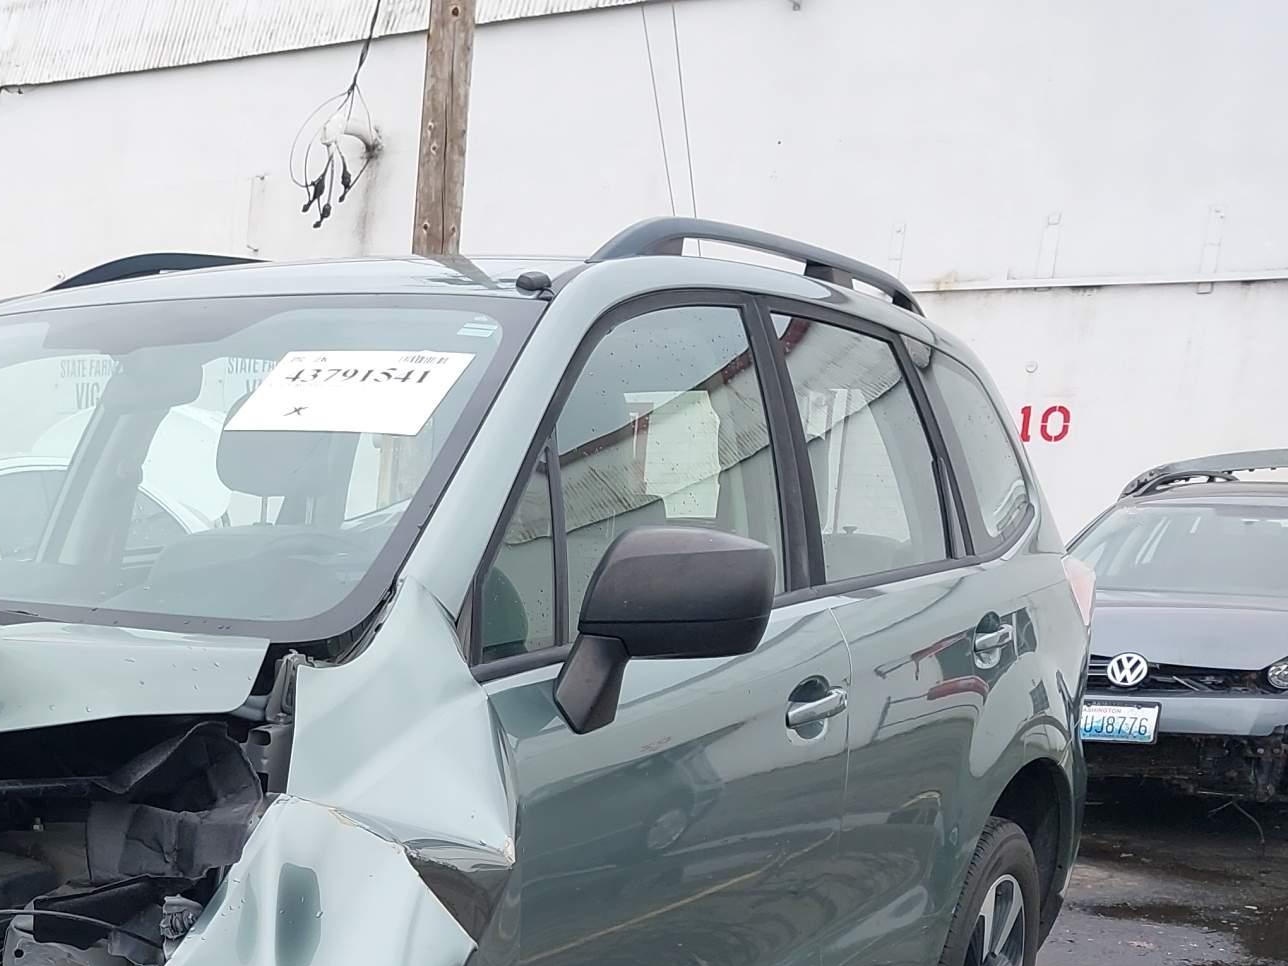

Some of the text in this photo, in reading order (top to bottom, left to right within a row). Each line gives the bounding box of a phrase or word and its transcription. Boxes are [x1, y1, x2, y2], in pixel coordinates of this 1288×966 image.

[60, 359, 87, 378] STATE
[284, 367, 432, 384] 43791541
[1020, 405, 1071, 442] 10
[1081, 715, 1149, 736] UJ8776
